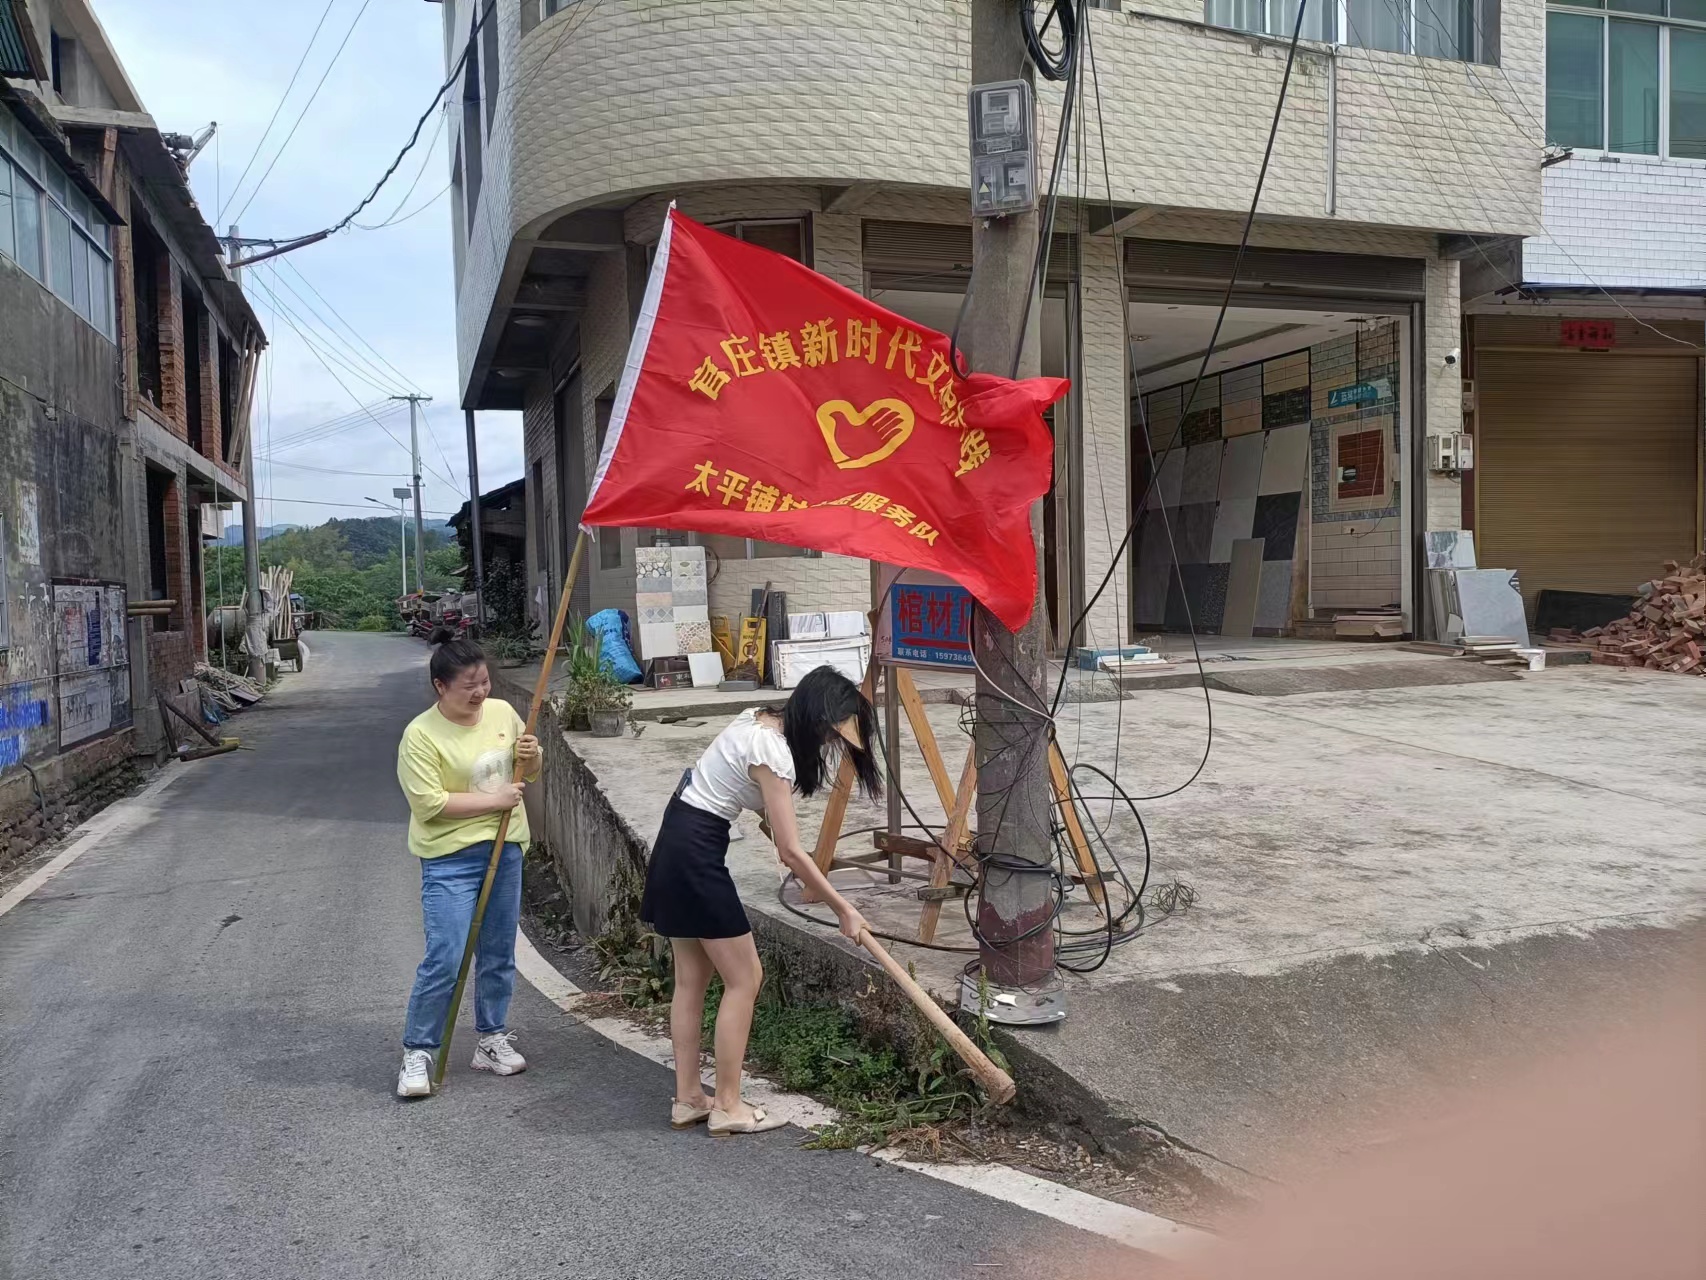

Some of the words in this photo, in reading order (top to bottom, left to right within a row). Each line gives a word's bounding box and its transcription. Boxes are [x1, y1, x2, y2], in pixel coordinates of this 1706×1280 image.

[684, 460, 940, 547] 太平铺村服务队
[935, 652, 974, 662] 15973649
